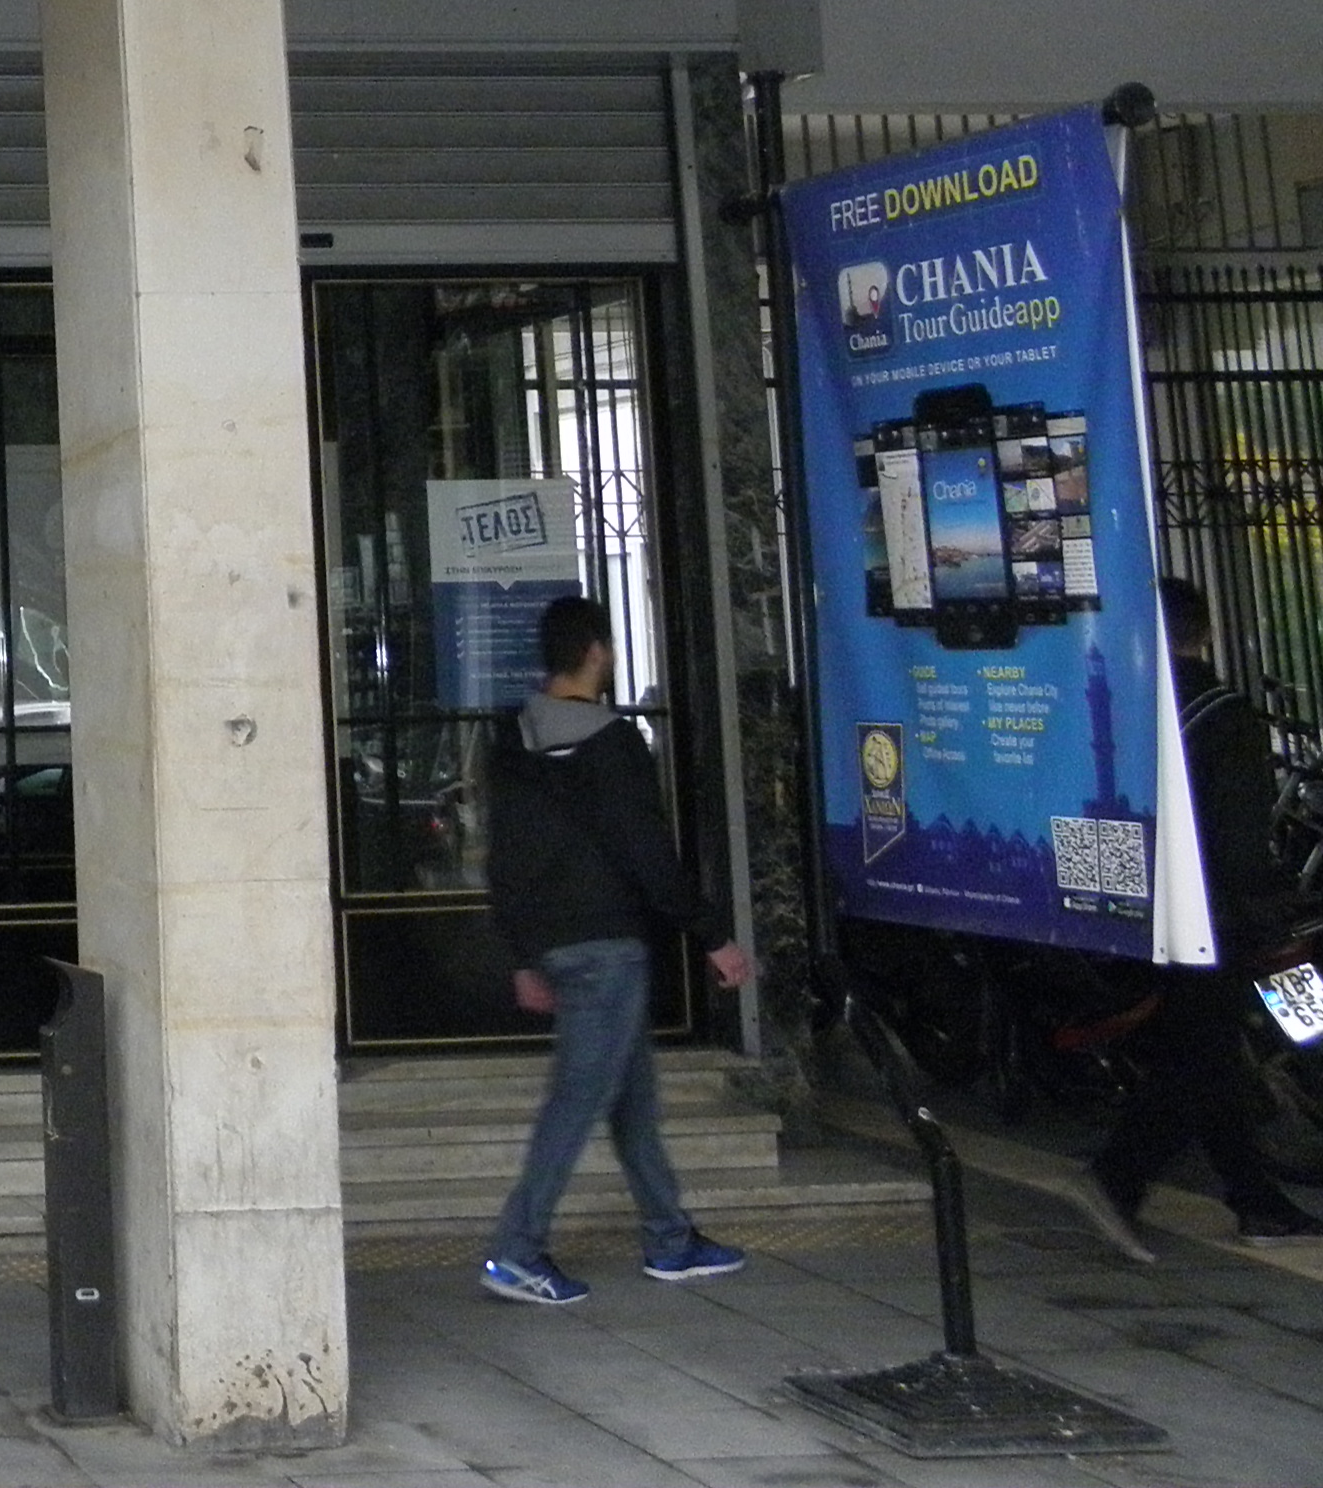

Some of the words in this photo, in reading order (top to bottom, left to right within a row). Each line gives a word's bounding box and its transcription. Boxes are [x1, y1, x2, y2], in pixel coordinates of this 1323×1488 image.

[830, 192, 881, 232] FREE
[884, 154, 1038, 220] DOWNLOAD
[896, 239, 1049, 306] CHANIA
[849, 330, 888, 351] Chania
[865, 370, 890, 386] YOUR
[892, 366, 926, 381] MOBILE
[928, 359, 965, 375] DEVICE
[983, 352, 1013, 368] YOUR
[1016, 345, 1057, 363] TABLET
[933, 478, 977, 500] Chania
[461, 505, 537, 545] ΤΕΛΟΣ
[982, 665, 1027, 680] NEARBY
[986, 682, 1017, 697] Explore
[1005, 717, 1045, 731] PLACES
